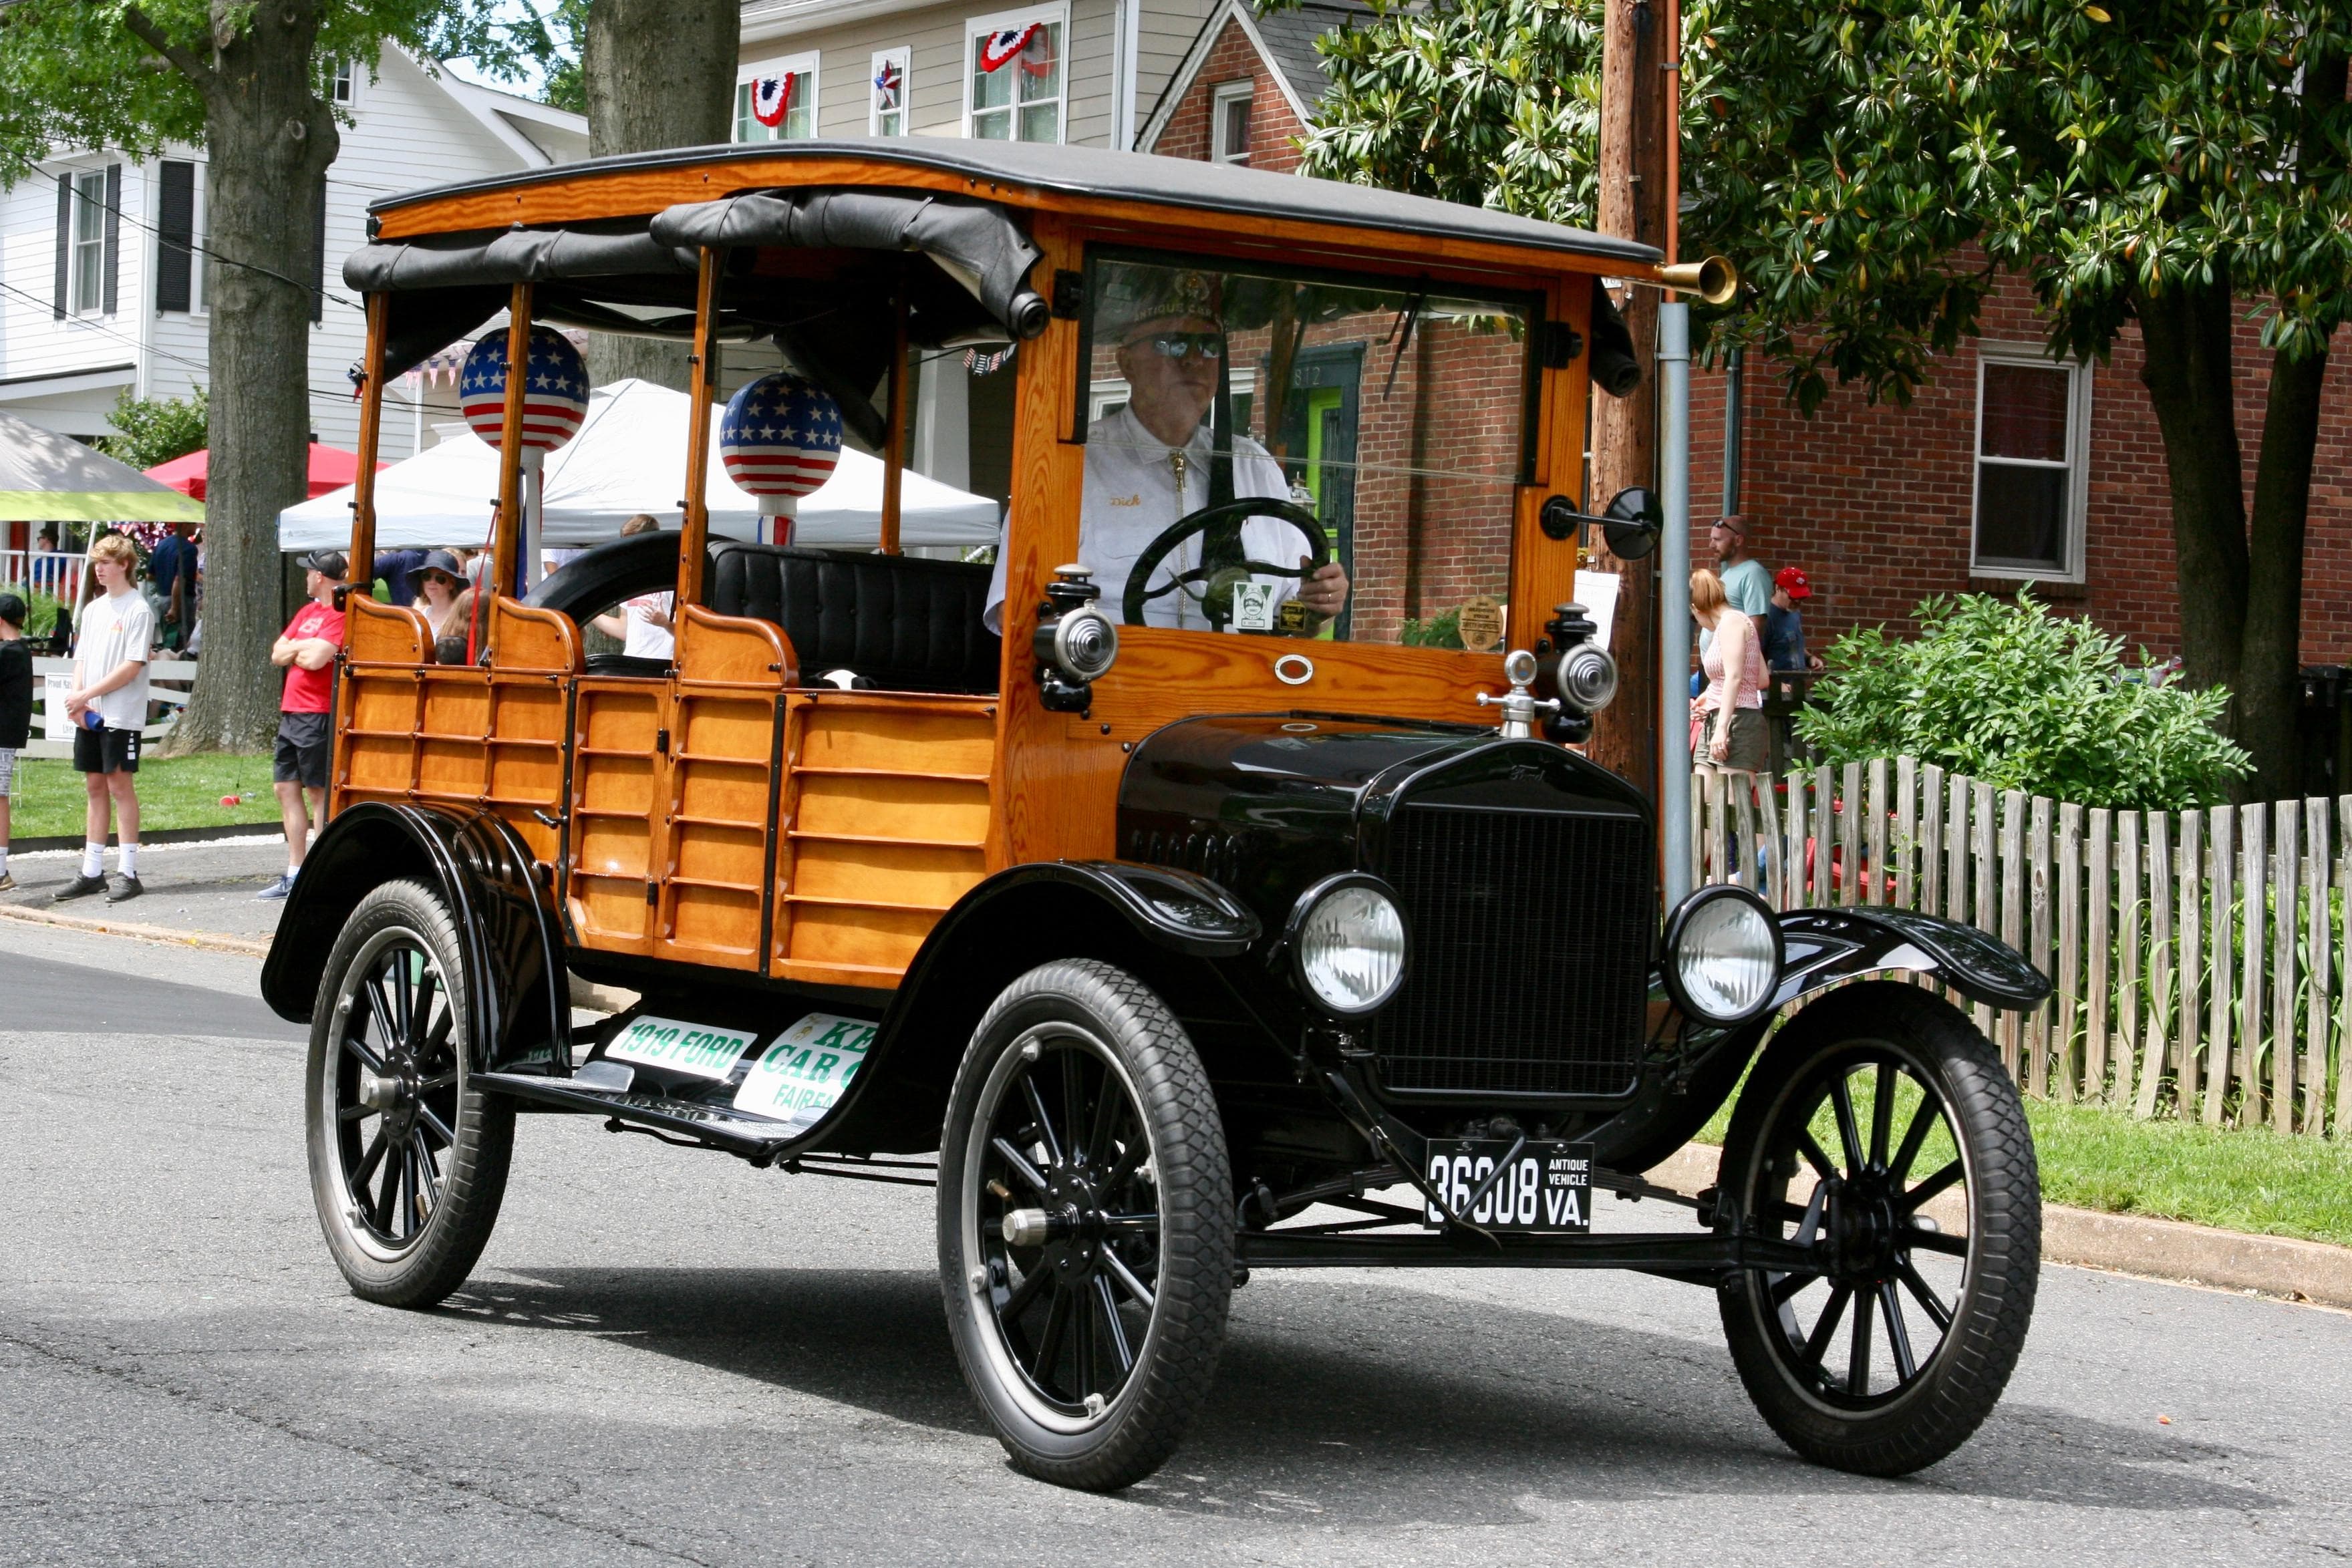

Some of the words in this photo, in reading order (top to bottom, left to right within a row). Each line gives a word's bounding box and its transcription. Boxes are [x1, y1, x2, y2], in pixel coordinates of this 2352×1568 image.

[1110, 493, 1141, 506] Dick
[620, 1023, 680, 1057] 1919
[670, 1031, 744, 1069] FORD
[763, 1044, 840, 1084] CAR
[1549, 1159, 1588, 1171] ANTIQUE
[1549, 1174, 1587, 1186] VEHICLE
[1544, 1189, 1589, 1225] VA.
